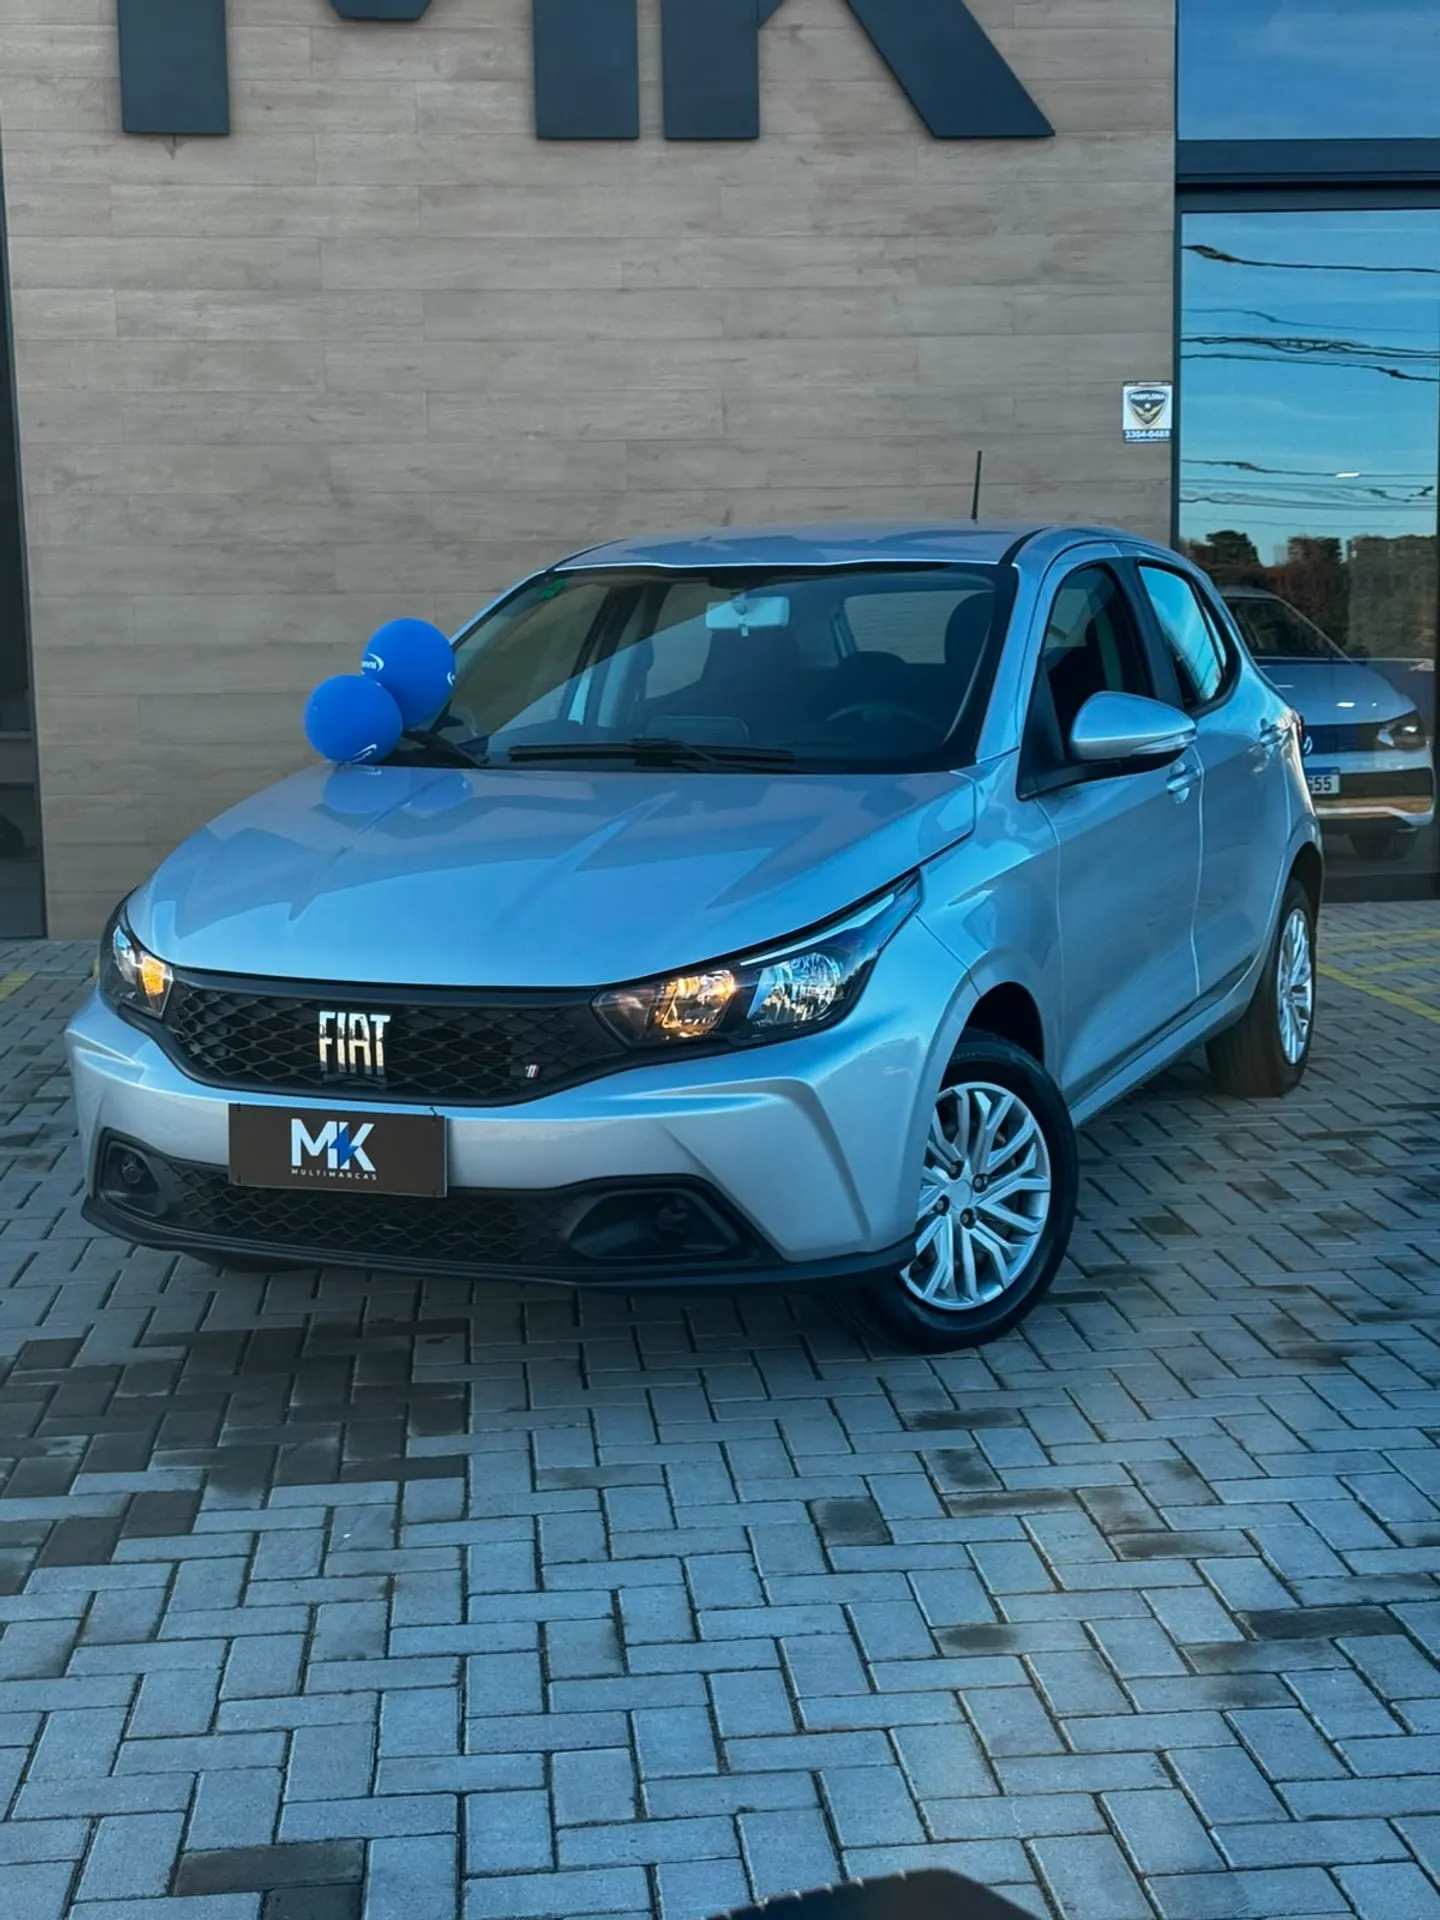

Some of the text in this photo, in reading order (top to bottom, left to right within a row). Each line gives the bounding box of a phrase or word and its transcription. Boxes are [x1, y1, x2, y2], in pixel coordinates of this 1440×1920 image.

[319, 1011, 391, 1076] FIAT
[291, 1118, 376, 1172] MK
[291, 1168, 377, 1181] MULTIMARCAS
